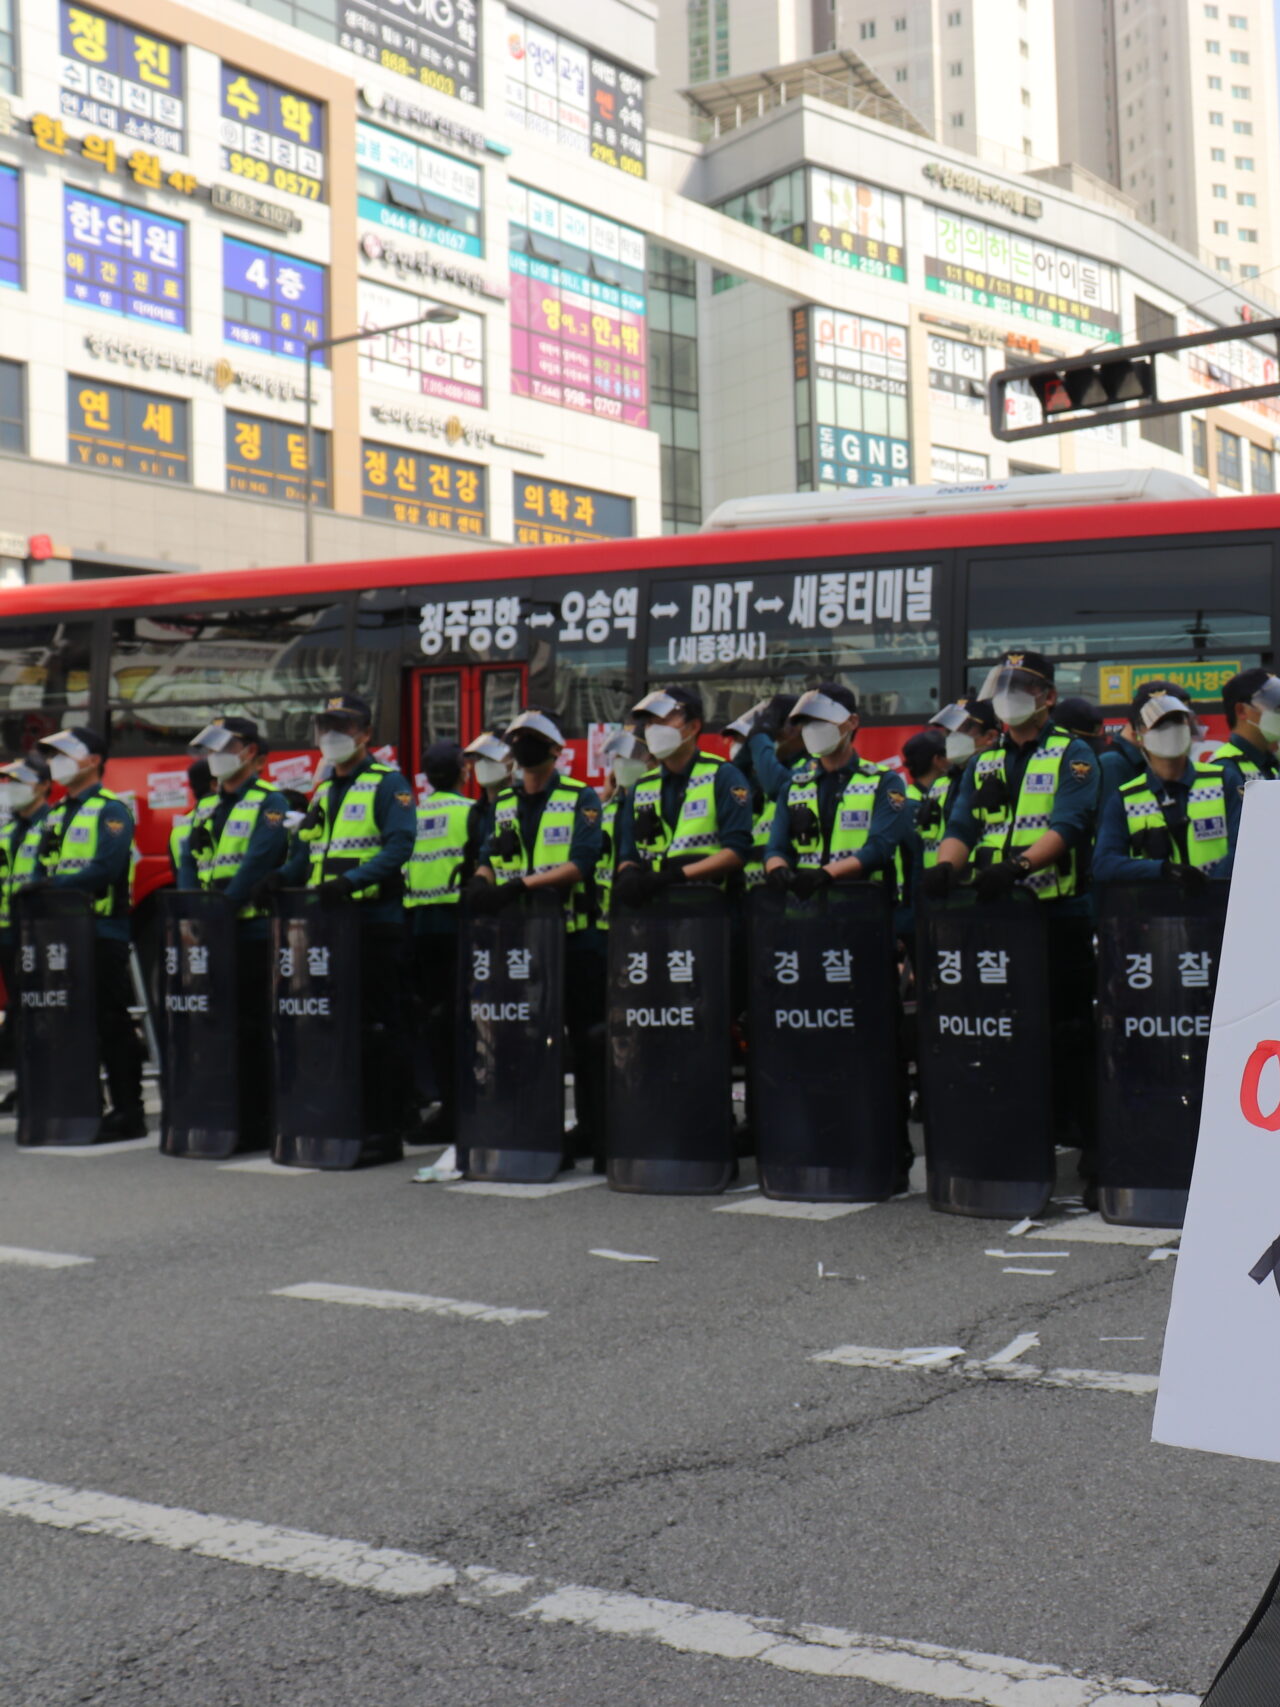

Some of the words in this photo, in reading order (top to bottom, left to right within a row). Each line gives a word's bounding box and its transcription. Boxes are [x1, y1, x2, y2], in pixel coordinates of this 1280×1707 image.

[68, 7, 171, 89] 정진
[225, 75, 313, 143] 수학
[31, 111, 163, 190] 한의원
[229, 153, 270, 183] 999
[272, 169, 321, 200] 0577
[66, 199, 178, 268] 한의원
[245, 258, 306, 301] 4층
[819, 318, 904, 357] prime
[931, 338, 977, 371] 영어
[78, 389, 174, 444] 연세
[841, 433, 909, 469] GNB
[523, 484, 595, 527] 의학과
[419, 596, 522, 655] 청주공항
[558, 586, 639, 643] 오송역
[690, 580, 755, 634] BRT
[788, 565, 934, 629] 세종터미널
[668, 631, 768, 667] [세종청사]
[21, 943, 67, 972] 경찰
[164, 945, 209, 975] 경찰
[279, 946, 331, 977] 경찰
[472, 948, 532, 981] 경찰
[626, 950, 695, 984] 경찰
[774, 949, 853, 984] 경찰
[937, 950, 1010, 985] 경찰
[1126, 951, 1212, 990] 경찰
[21, 989, 67, 1007] POLICE
[165, 993, 208, 1012] POLICE
[279, 998, 330, 1017] POLICE
[471, 1002, 530, 1022] POLICE
[626, 1006, 694, 1028] POLICE
[775, 1008, 855, 1029] POLICE
[939, 1015, 1013, 1038] POLICE
[1125, 1015, 1211, 1038] POLICE
